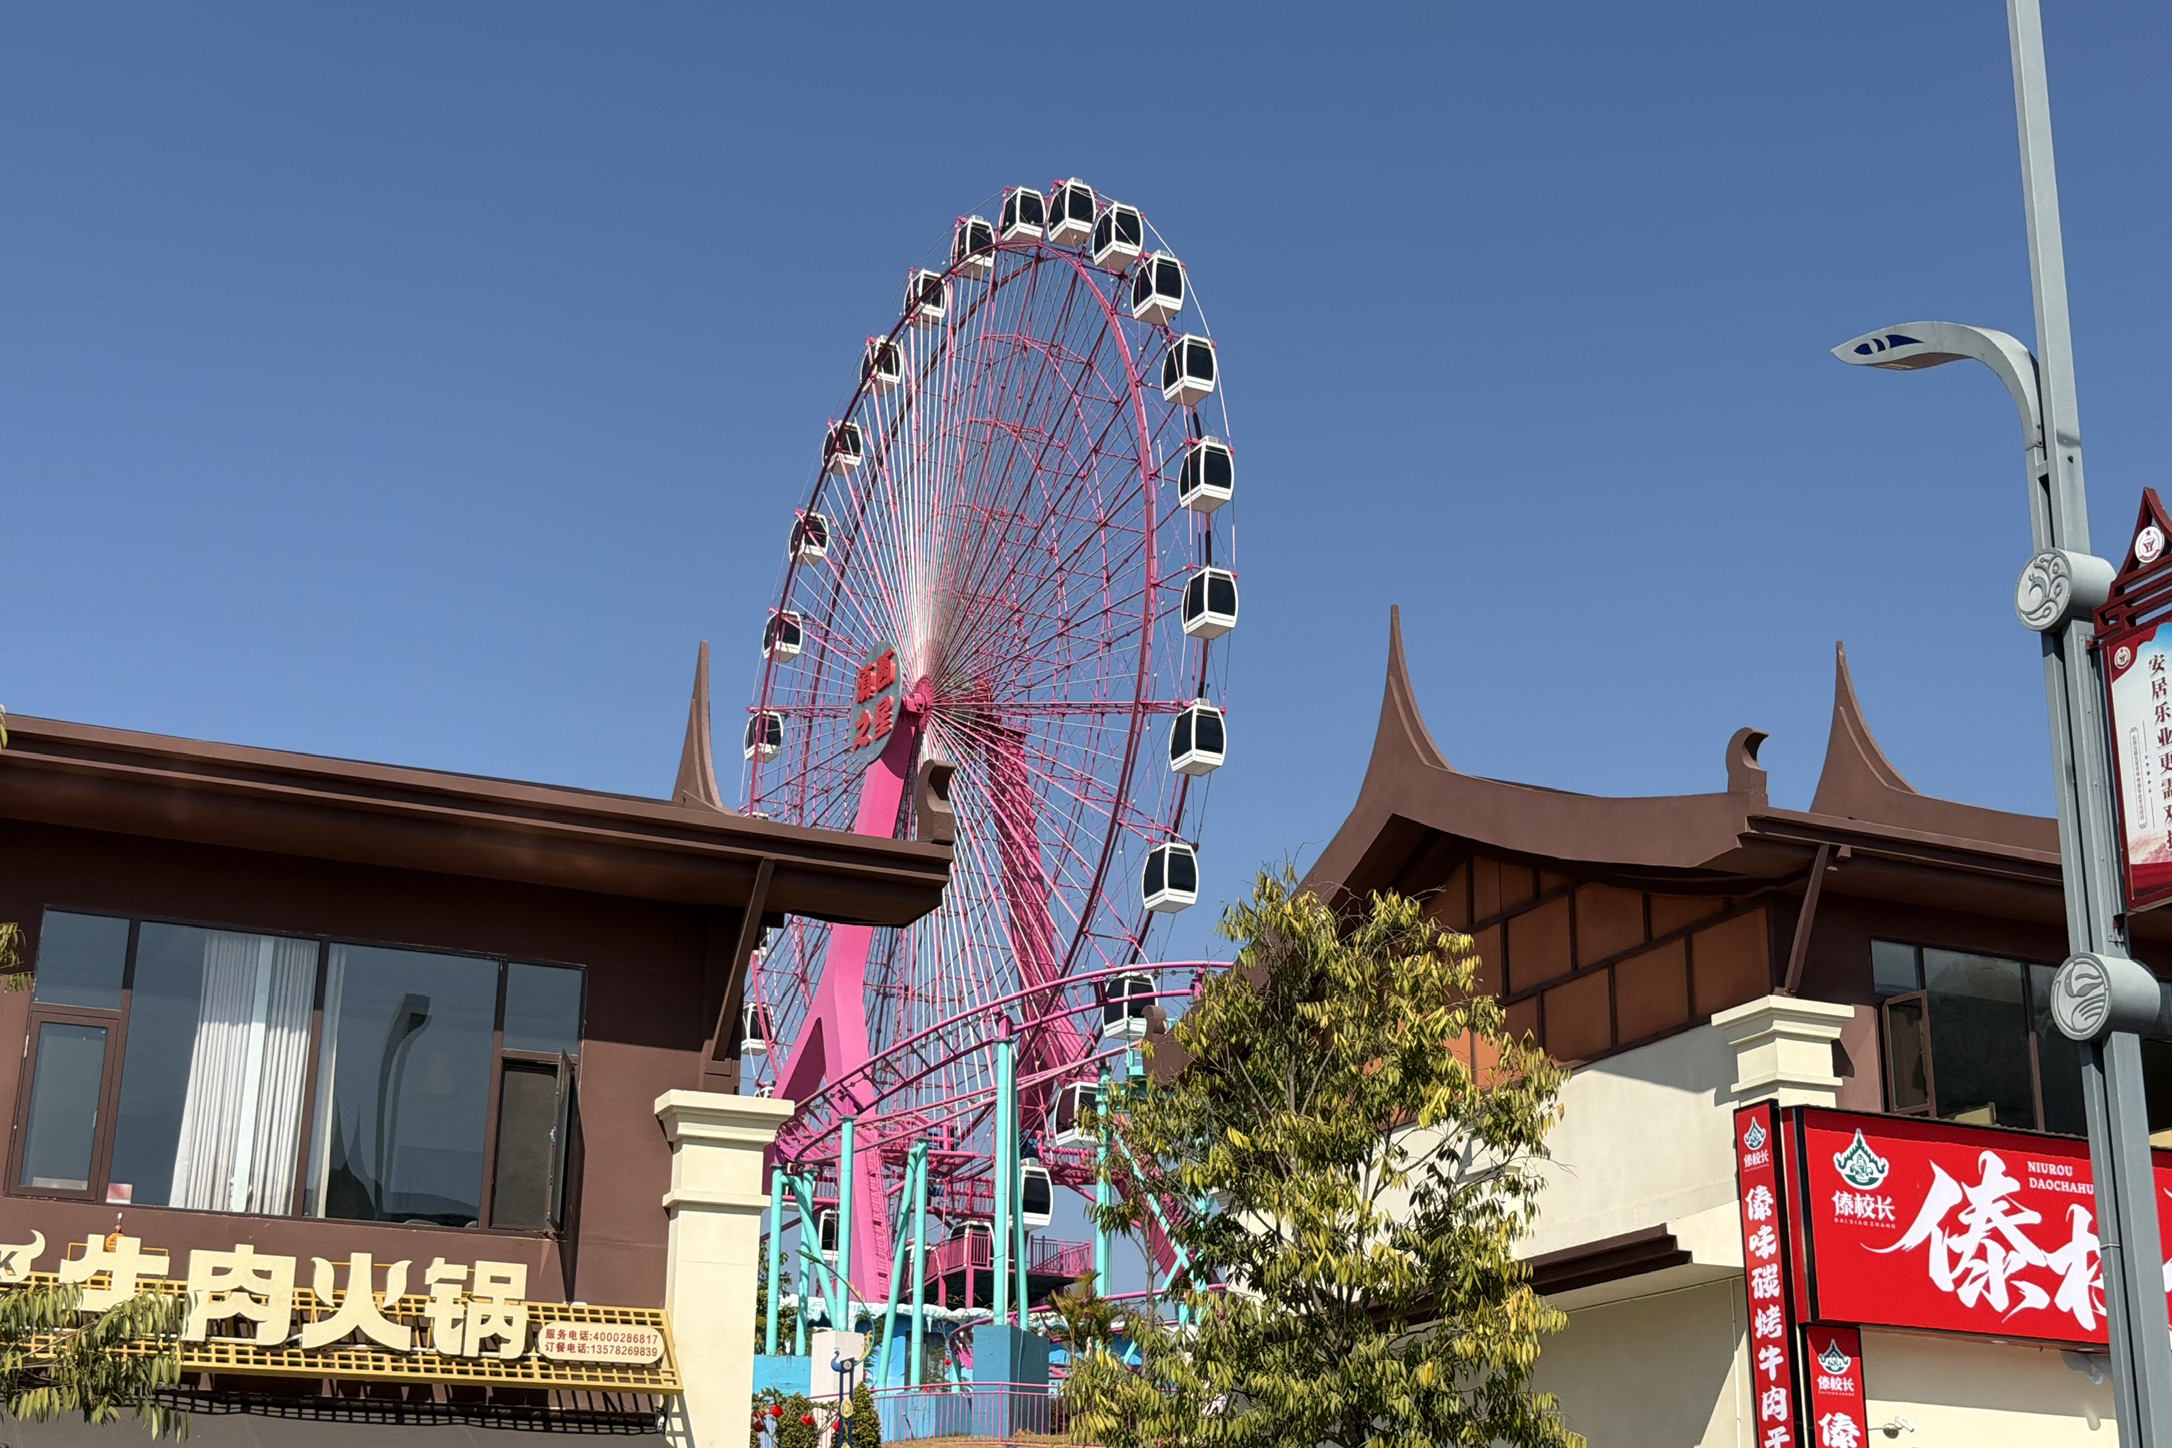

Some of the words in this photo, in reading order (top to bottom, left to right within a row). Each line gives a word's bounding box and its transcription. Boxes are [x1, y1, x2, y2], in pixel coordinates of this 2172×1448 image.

[852, 695, 894, 752] 之星
[2148, 654, 2172, 851] 安居乐业更需
[1743, 1149, 1769, 1169] 傣校长
[2027, 1160, 2073, 1177] NIUROU
[1831, 1190, 1896, 1221] 傣校长
[59, 1233, 529, 1360] 牛肉火锅
[1816, 1375, 1855, 1392] 傣校长
